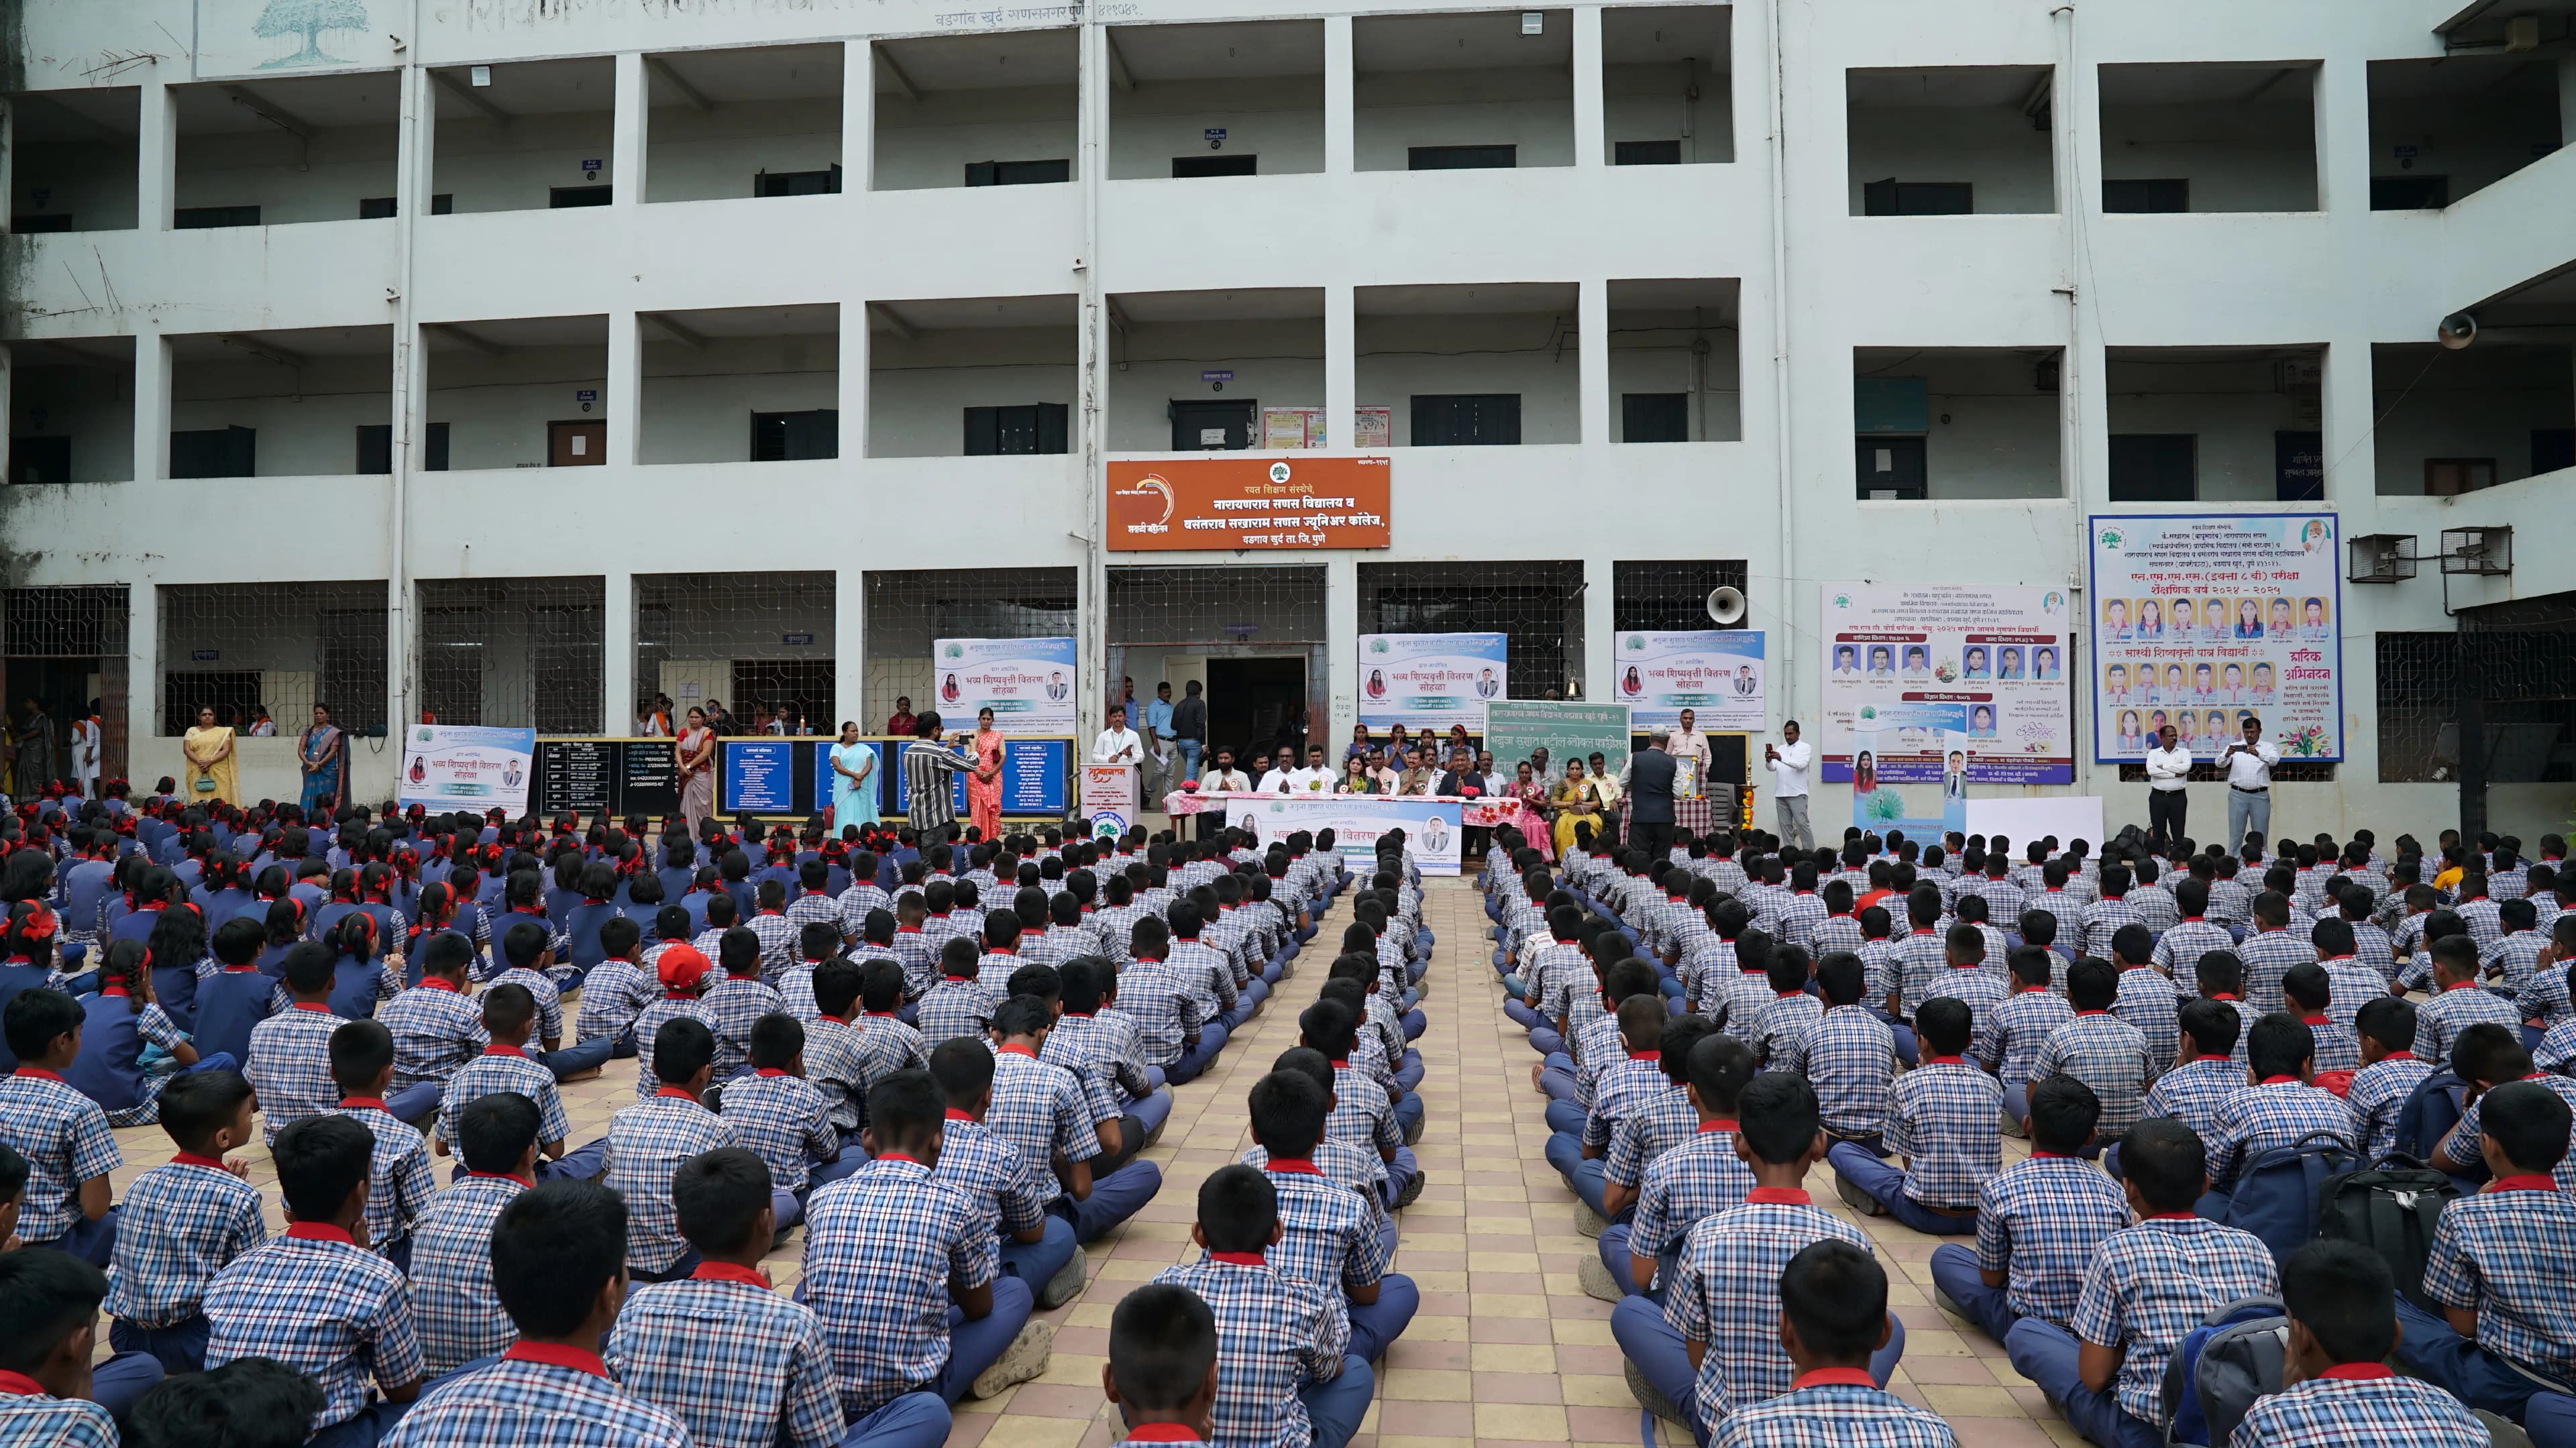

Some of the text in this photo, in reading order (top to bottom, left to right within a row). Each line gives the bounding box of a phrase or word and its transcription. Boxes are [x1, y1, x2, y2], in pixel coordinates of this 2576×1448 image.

[1244, 484, 1315, 496] रयत शिक्षण संस्थेचे,
[1214, 494, 1355, 511] नारायणराव सणस विद्यालय व
[1184, 510, 1385, 532] वसंतराव सखाराम सणस ज्यूनिअर कॉलेज,
[1242, 529, 1326, 547] वडगाव खुर्द ता. जि. पुणे
[2271, 571, 2300, 581] परीक्षा
[2151, 583, 2190, 596] शैक्षणिक
[2194, 583, 2208, 595] वर्ष
[2213, 586, 2239, 594] २०२४
[2125, 647, 2151, 657] सारथी
[2217, 645, 2249, 657] विद्यार्थी
[2289, 647, 2322, 663] हार्दिक
[966, 675, 981, 684] भव्य
[1018, 673, 1044, 684] वितरण
[1392, 672, 1407, 681] भव्य
[1447, 671, 1473, 681] वितरण
[1648, 669, 1664, 678] भव्य
[1704, 667, 1730, 678] वितरण
[2284, 665, 2330, 681] अभिनंदन
[1419, 682, 1446, 693] सोहळा
[1676, 678, 1703, 689] सोहळा
[991, 684, 1017, 696] सोहळा
[432, 760, 445, 768] भव्य
[480, 760, 501, 771] वितरण
[454, 770, 477, 779] सोहळा
[1344, 828, 1375, 841] वितरण
